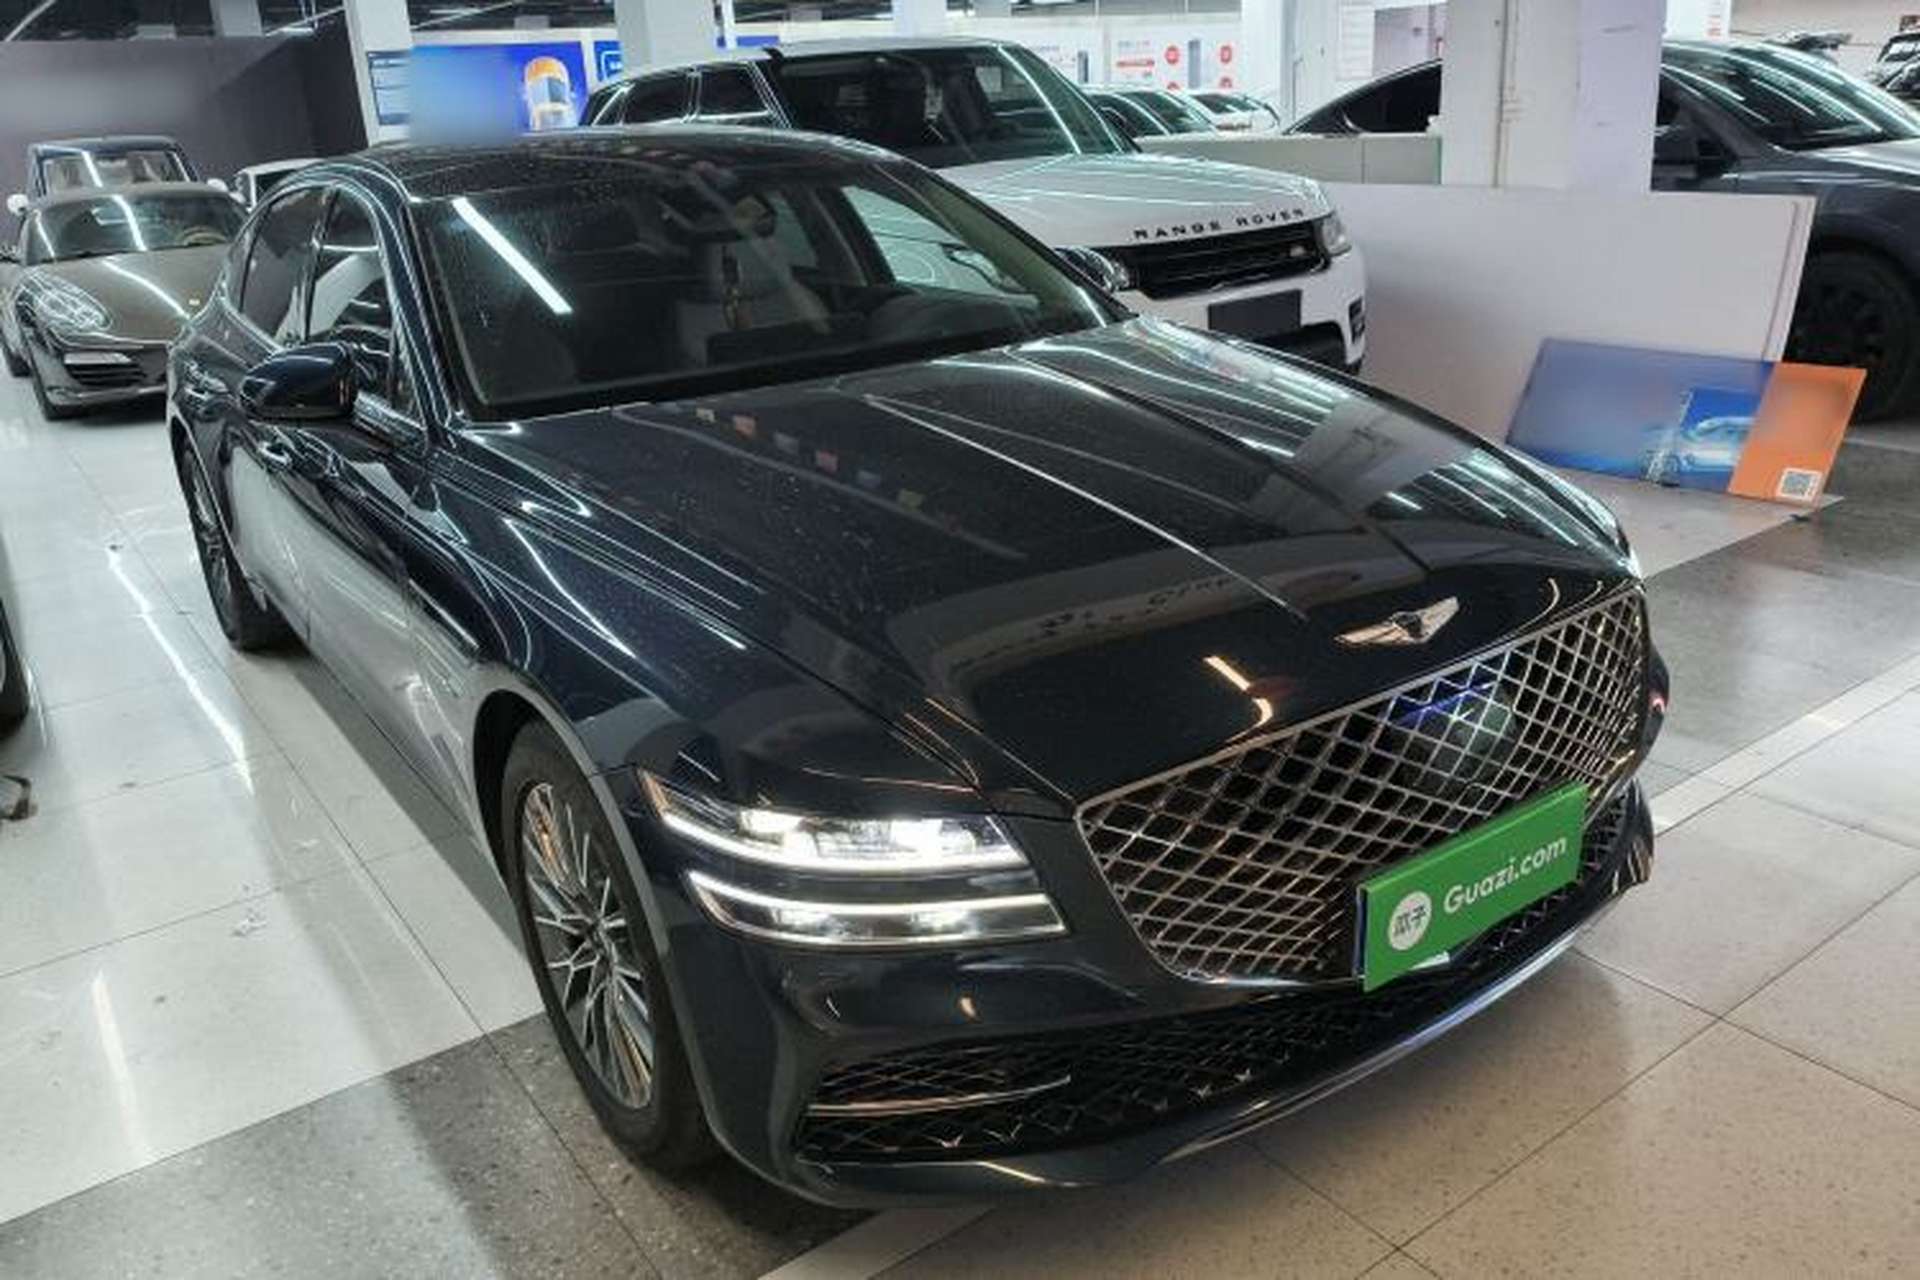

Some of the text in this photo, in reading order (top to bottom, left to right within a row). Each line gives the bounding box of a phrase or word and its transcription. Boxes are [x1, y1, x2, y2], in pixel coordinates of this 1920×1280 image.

[1133, 207, 1304, 239] RANGE ROVER
[1443, 837, 1567, 914] Guazi.com
